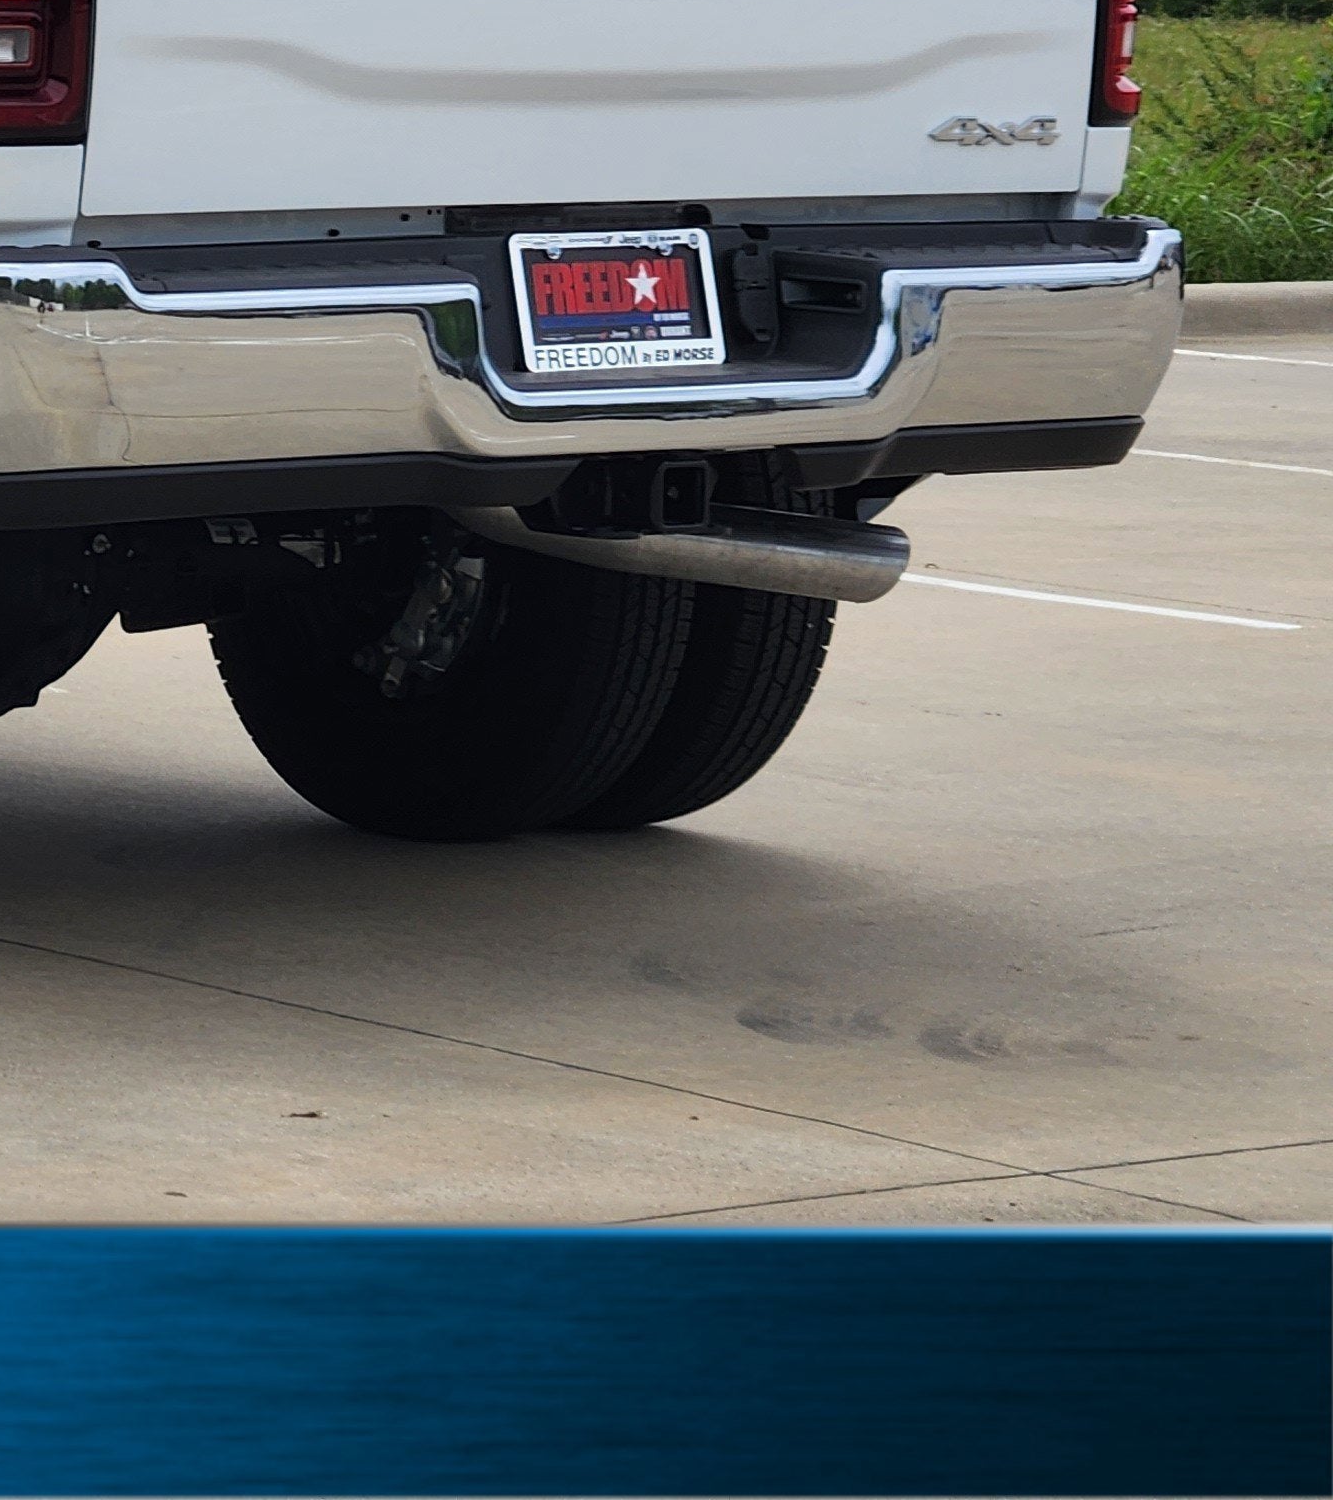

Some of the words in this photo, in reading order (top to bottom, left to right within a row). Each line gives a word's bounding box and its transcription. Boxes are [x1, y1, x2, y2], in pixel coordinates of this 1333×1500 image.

[927, 115, 1061, 146] 4x4
[535, 345, 638, 369] FREEDOM
[655, 349, 670, 362] ED
[673, 347, 714, 361] MORSE
